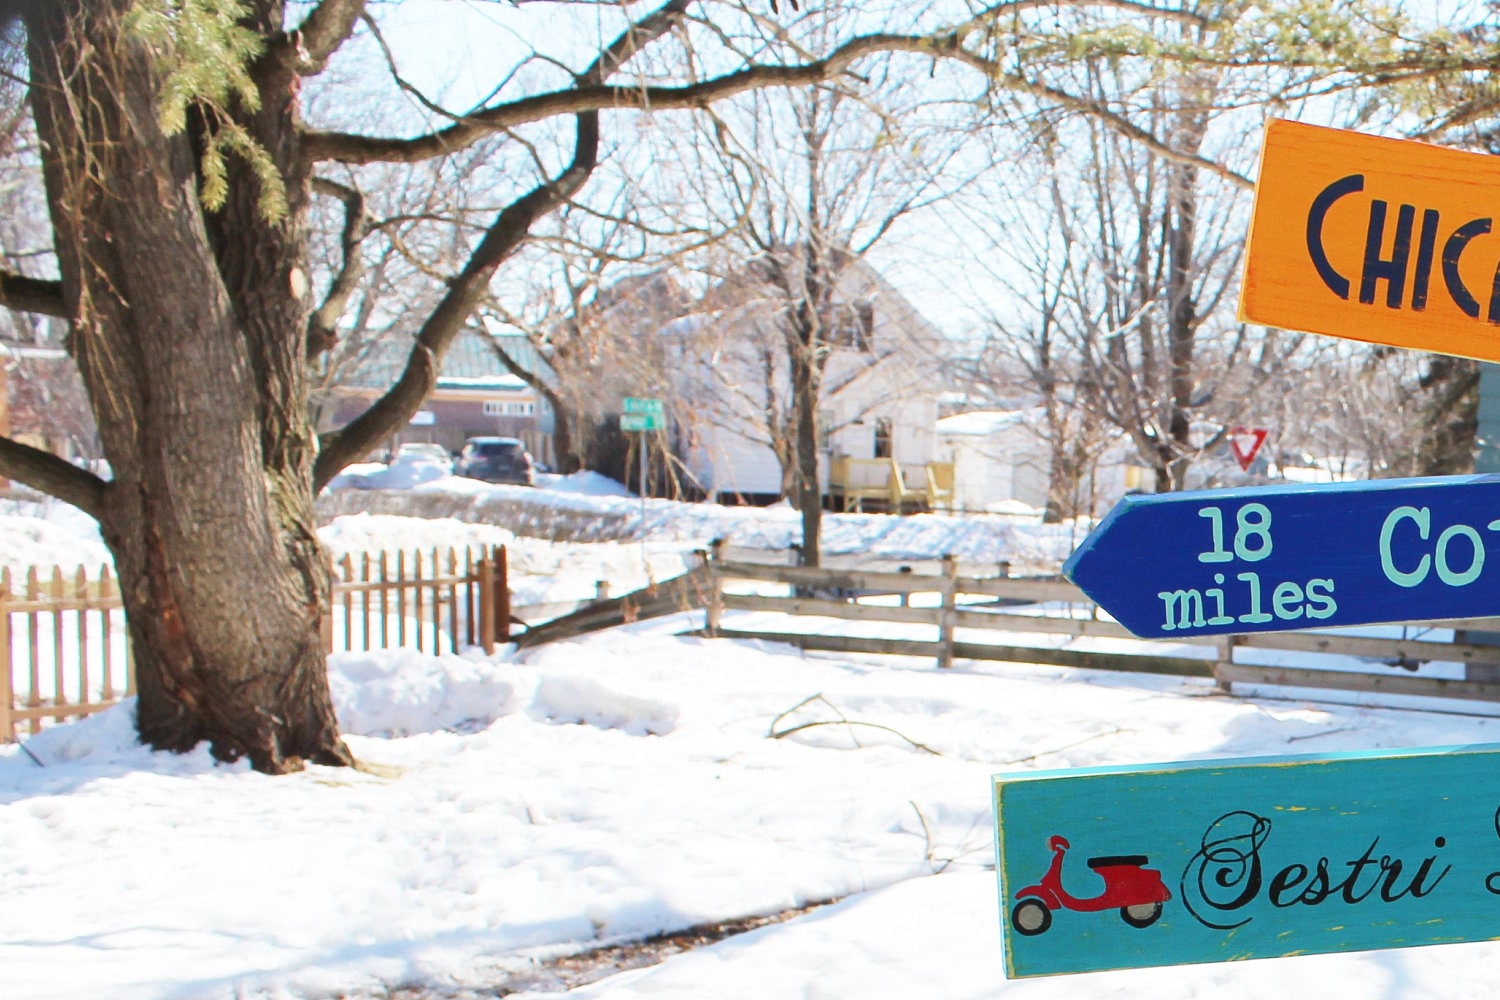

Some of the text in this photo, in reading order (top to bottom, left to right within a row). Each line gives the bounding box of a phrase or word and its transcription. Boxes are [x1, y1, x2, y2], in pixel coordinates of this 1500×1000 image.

[1196, 504, 1275, 564] 18
[1158, 573, 1336, 632] miles
[1181, 810, 1450, 930] Sestri
